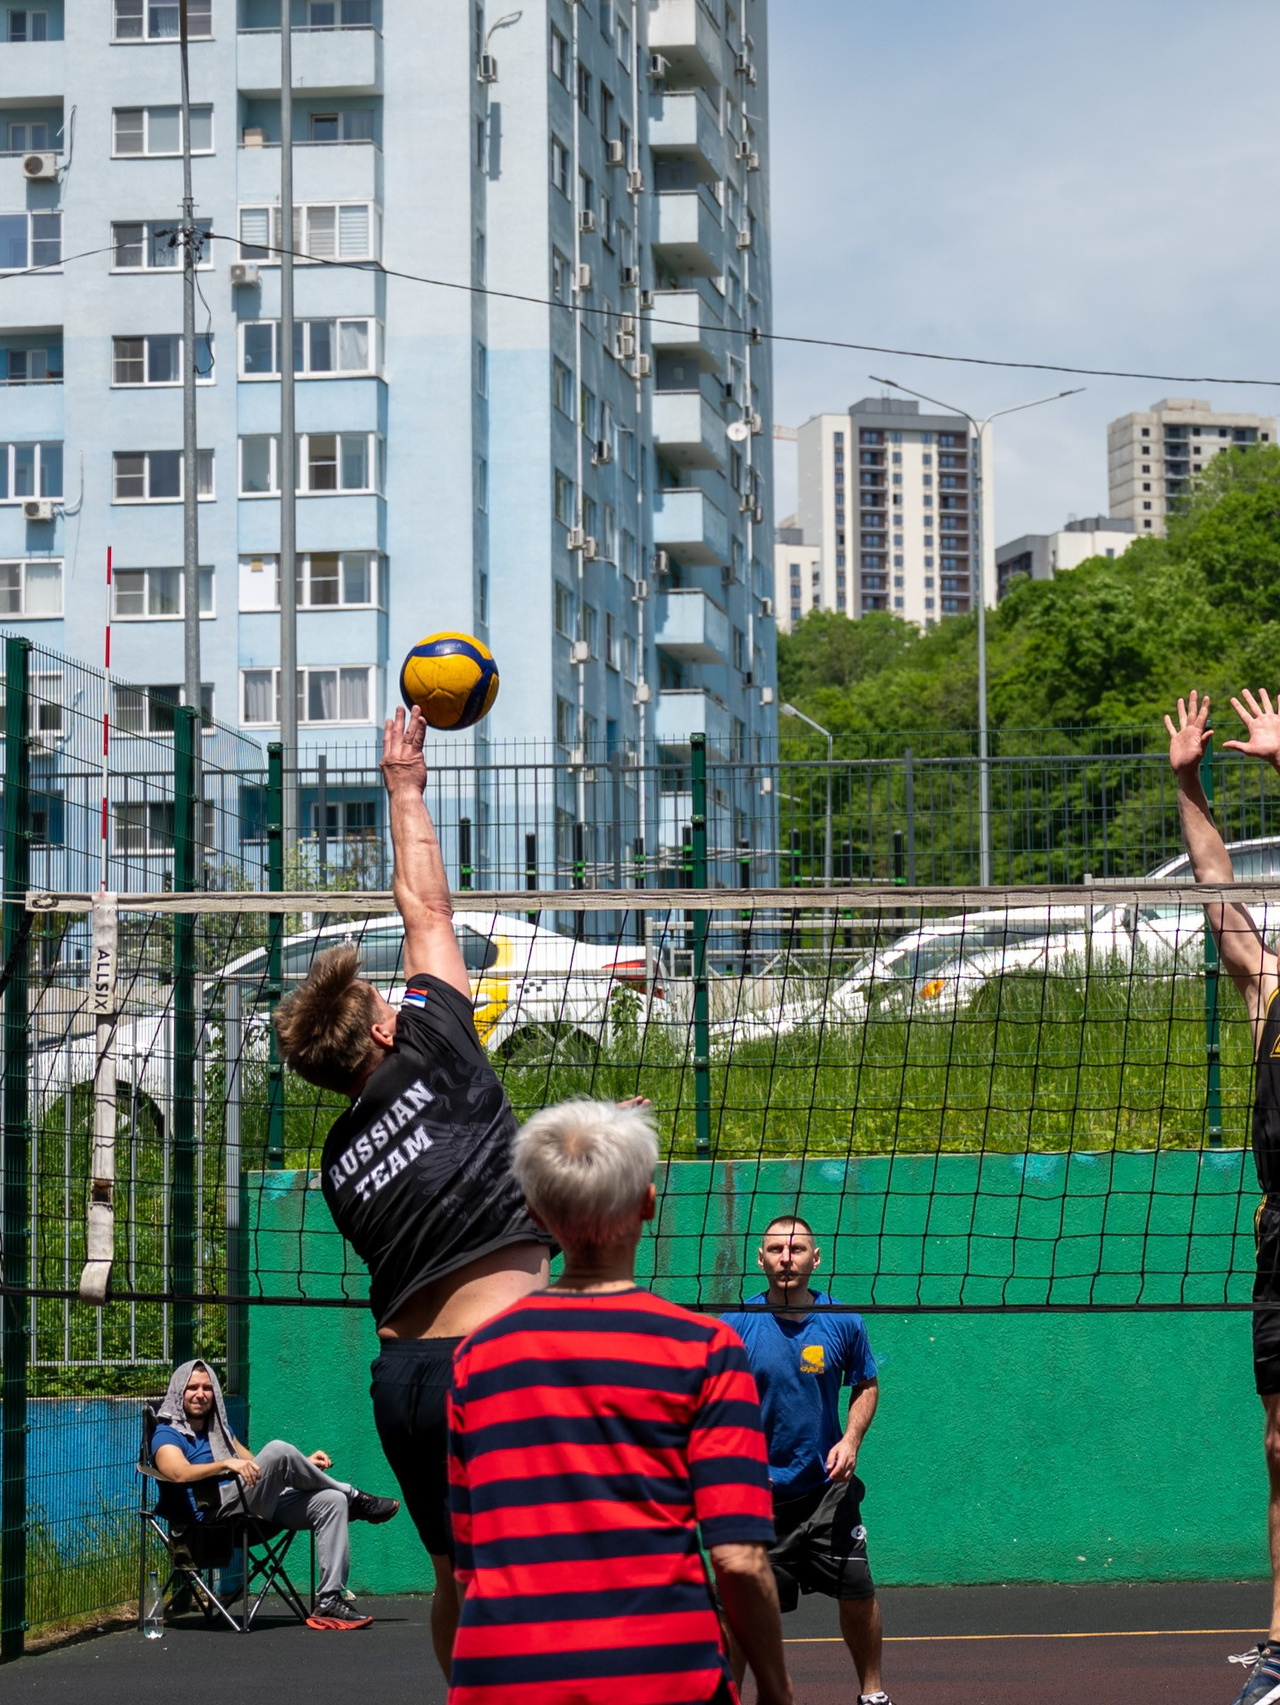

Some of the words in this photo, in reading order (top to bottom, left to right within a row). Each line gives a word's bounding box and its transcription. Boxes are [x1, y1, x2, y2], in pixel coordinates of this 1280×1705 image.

[94, 949, 111, 1010] ALLSIX
[328, 1078, 436, 1191] RUSSIAN
[354, 1123, 434, 1202] TEAM
